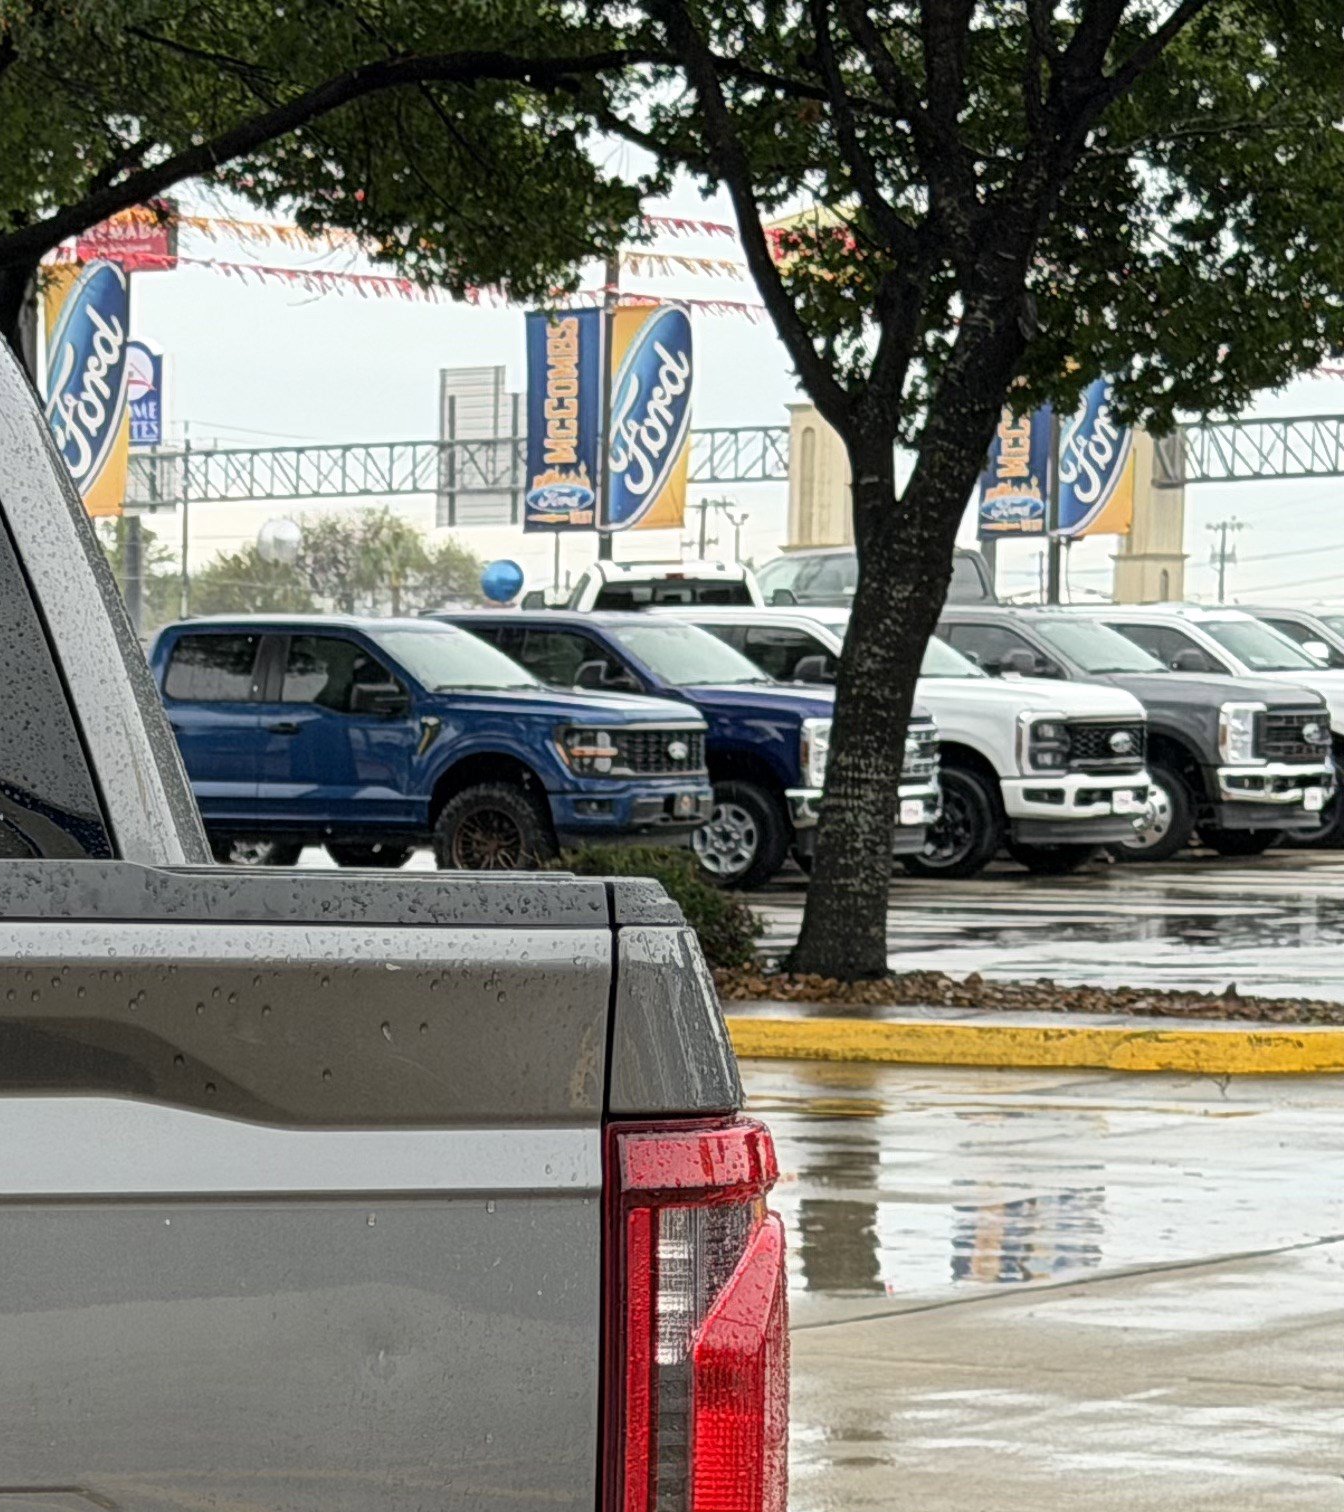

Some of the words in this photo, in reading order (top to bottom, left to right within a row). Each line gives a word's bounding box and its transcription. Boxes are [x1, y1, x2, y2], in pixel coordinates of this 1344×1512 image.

[45, 303, 124, 478] Ford
[608, 340, 691, 495] Ford
[1058, 392, 1119, 504] For
